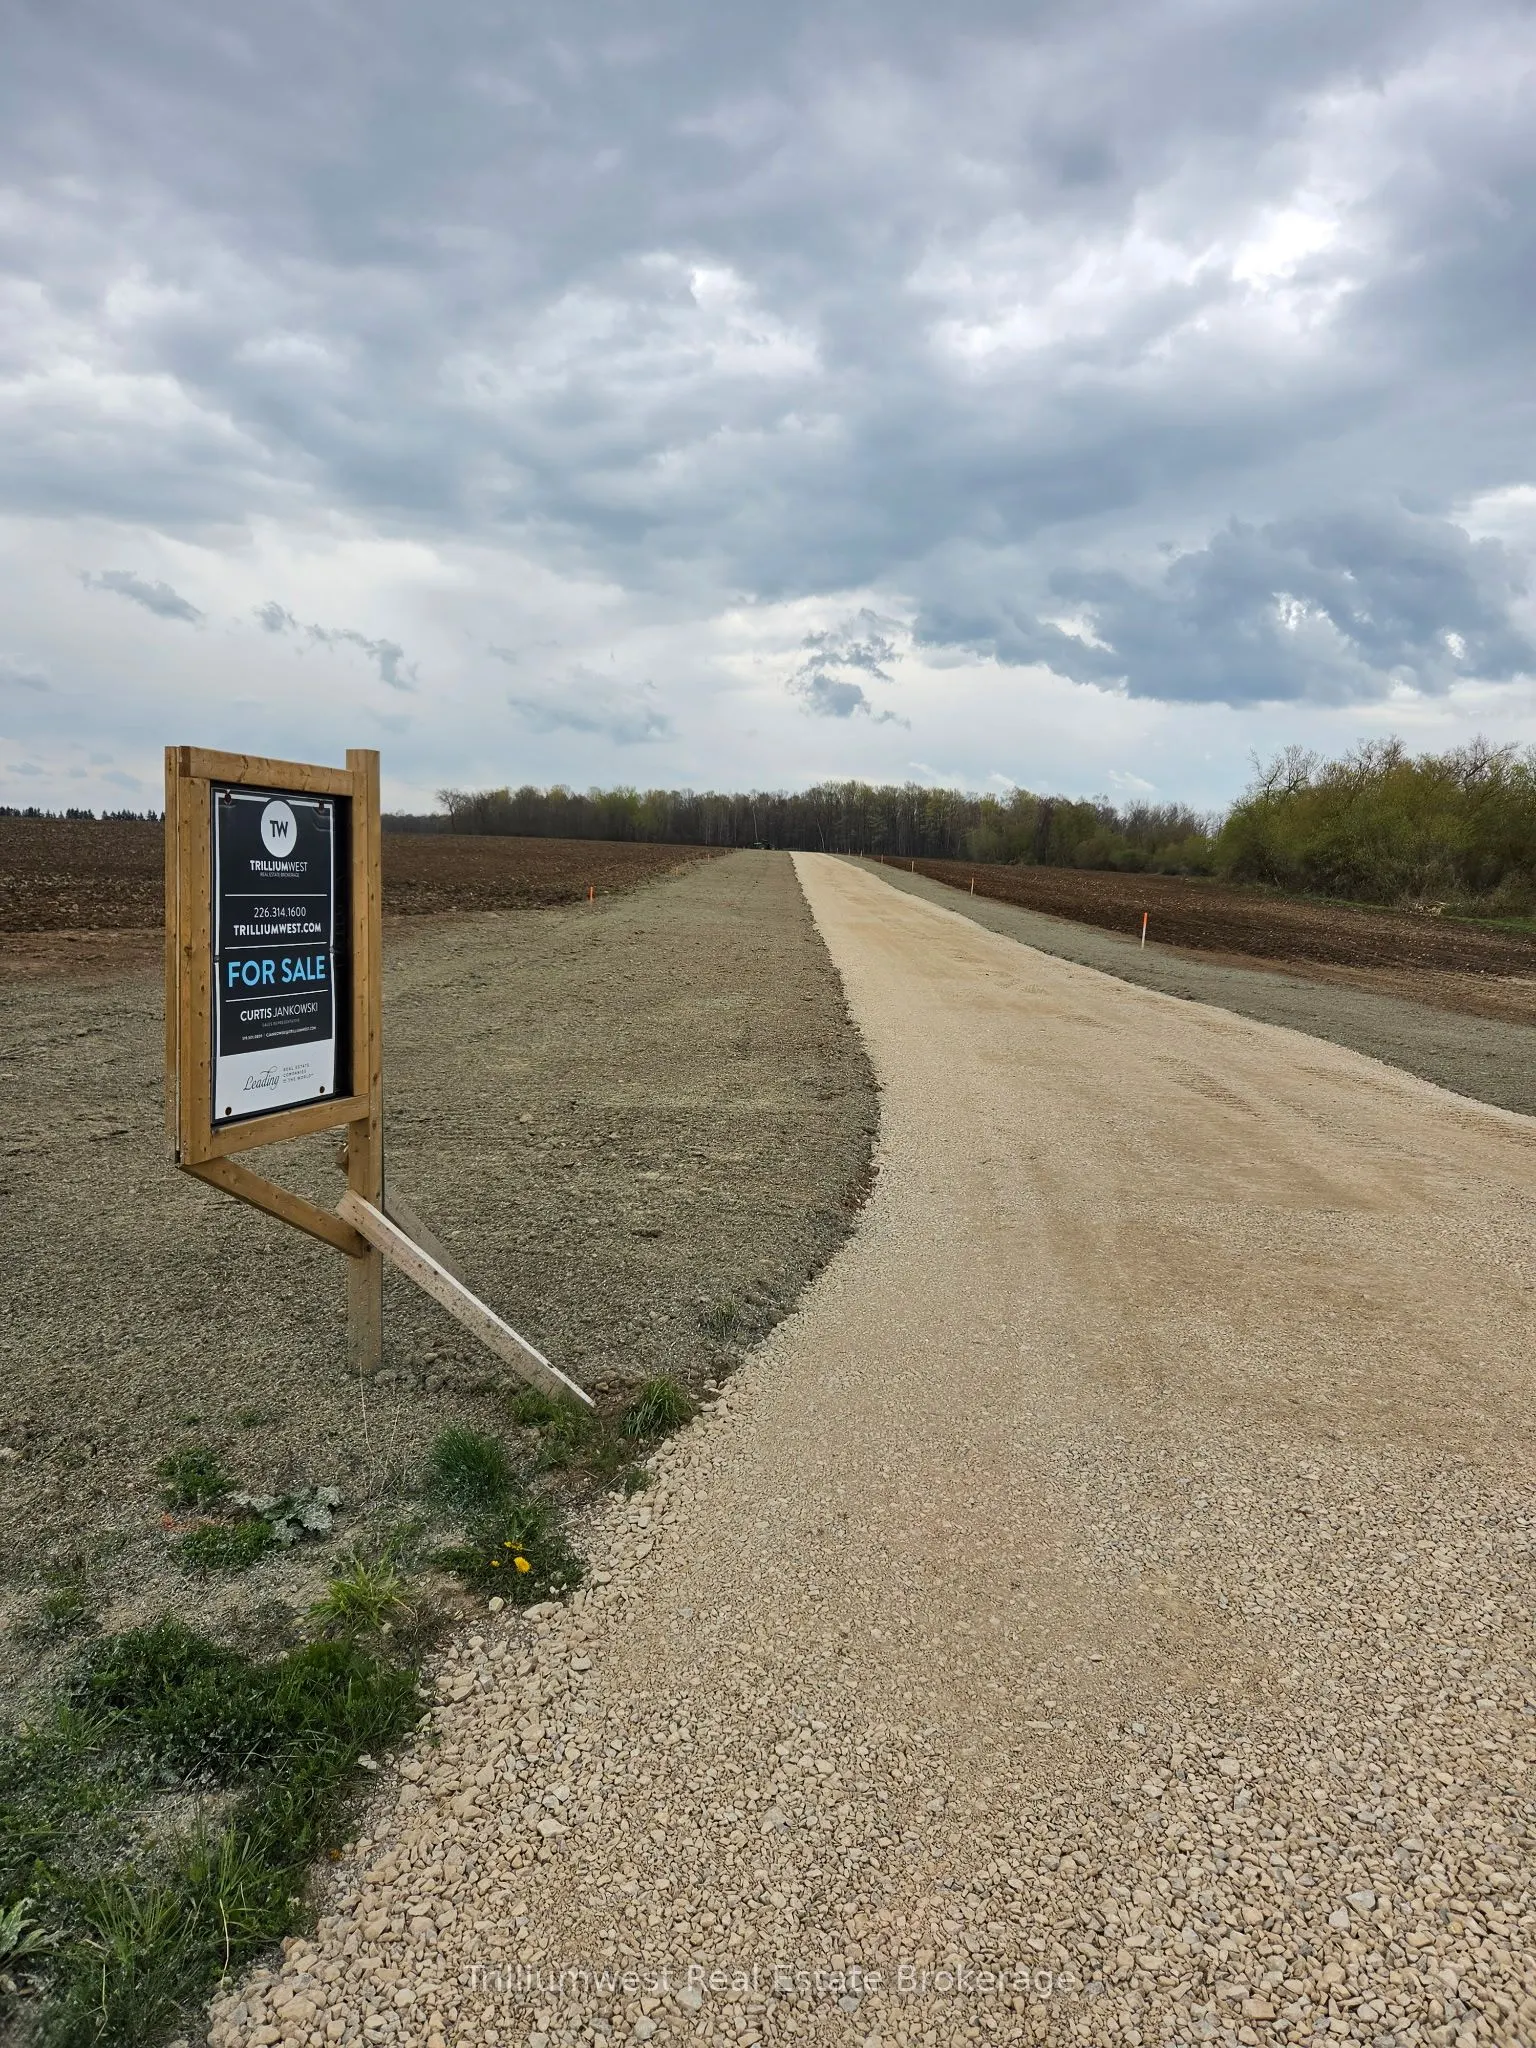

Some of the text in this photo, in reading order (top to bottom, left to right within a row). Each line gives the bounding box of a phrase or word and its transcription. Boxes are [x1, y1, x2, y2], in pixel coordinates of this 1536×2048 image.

[269, 820, 289, 838] TW
[249, 860, 308, 872] TRILLIUMWEST
[253, 906, 307, 918] 226.314.1600
[233, 922, 322, 936] TRILLIUMWEST.COM
[228, 955, 326, 988] FOR SALE
[240, 1002, 319, 1021] CURTIS JANKOWSKI
[243, 1065, 280, 1091] Leading
